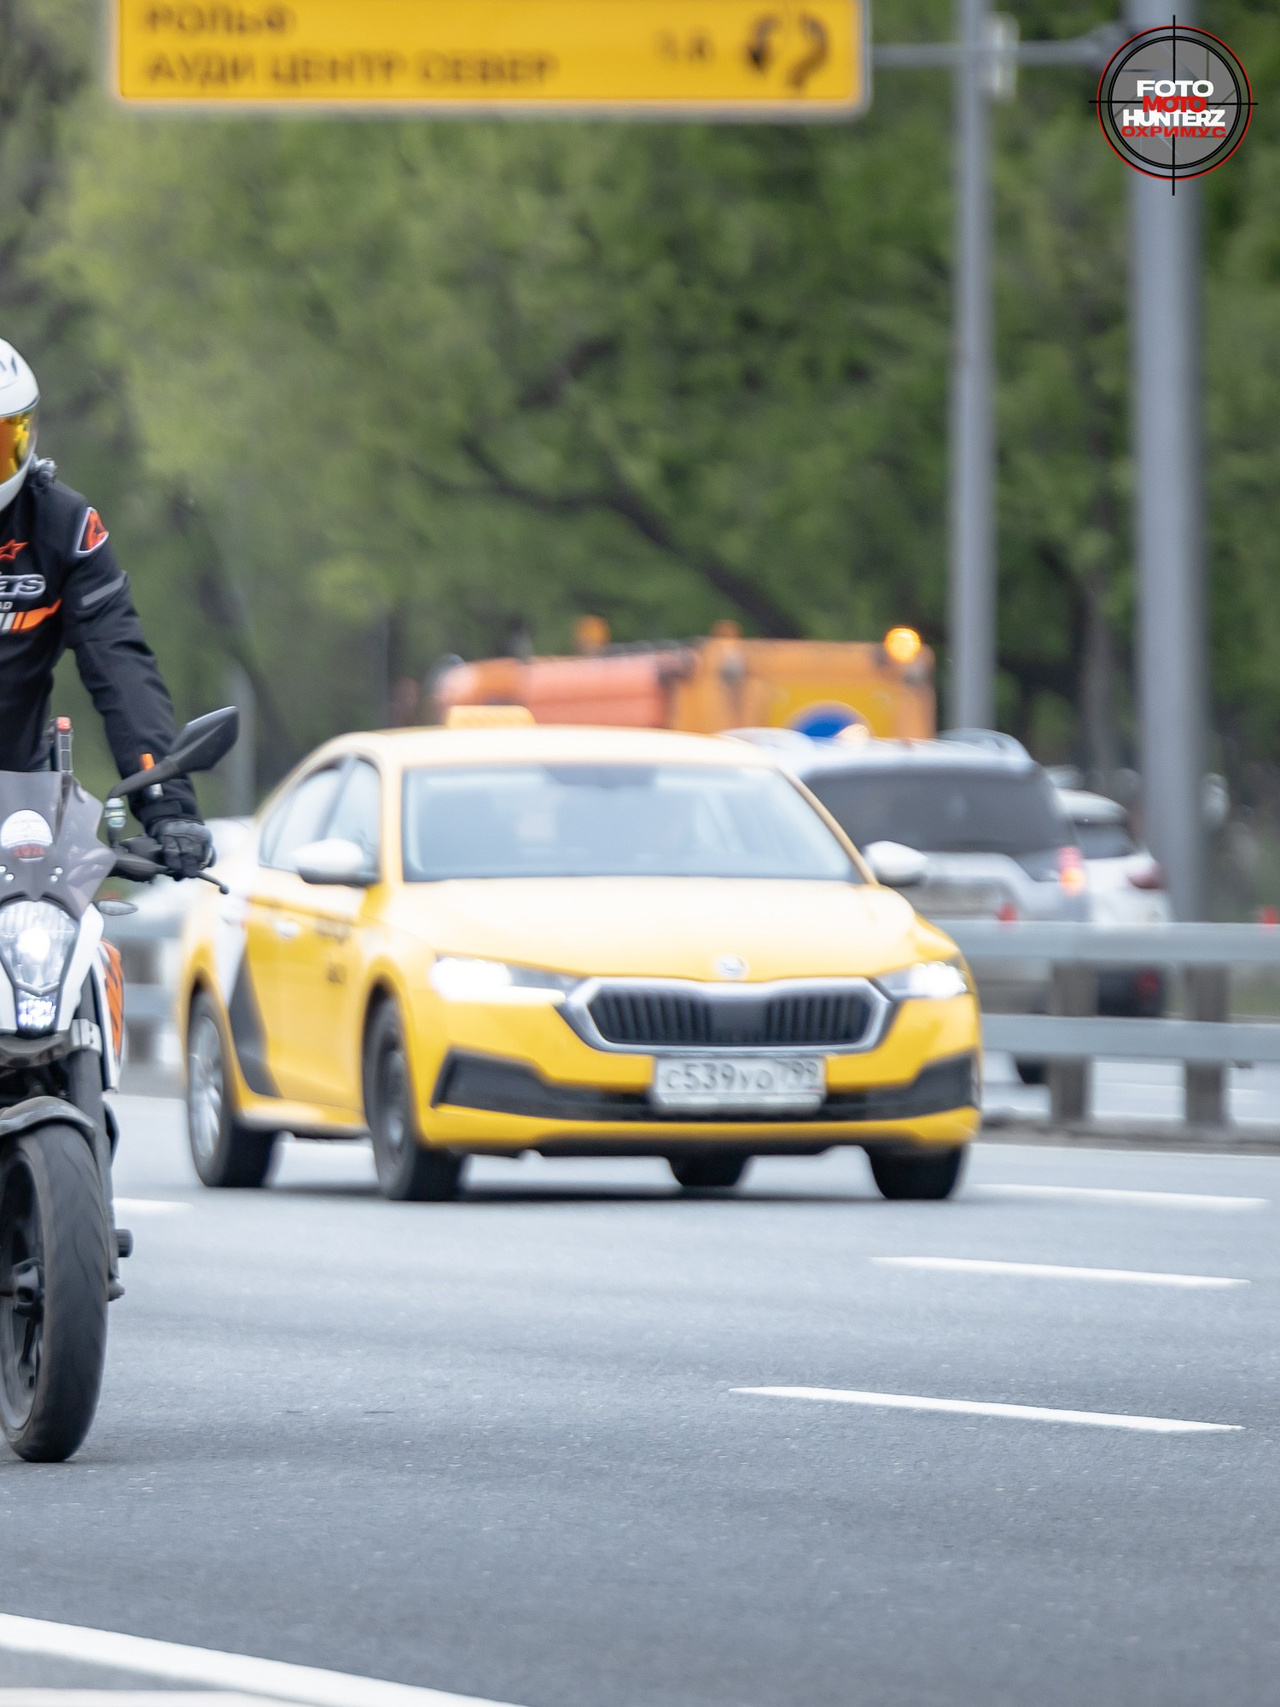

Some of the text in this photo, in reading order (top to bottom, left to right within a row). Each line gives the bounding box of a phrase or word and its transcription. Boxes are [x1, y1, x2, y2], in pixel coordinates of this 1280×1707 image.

[147, 50, 558, 88] АУДИ ЦЕНТР СЕВЕР
